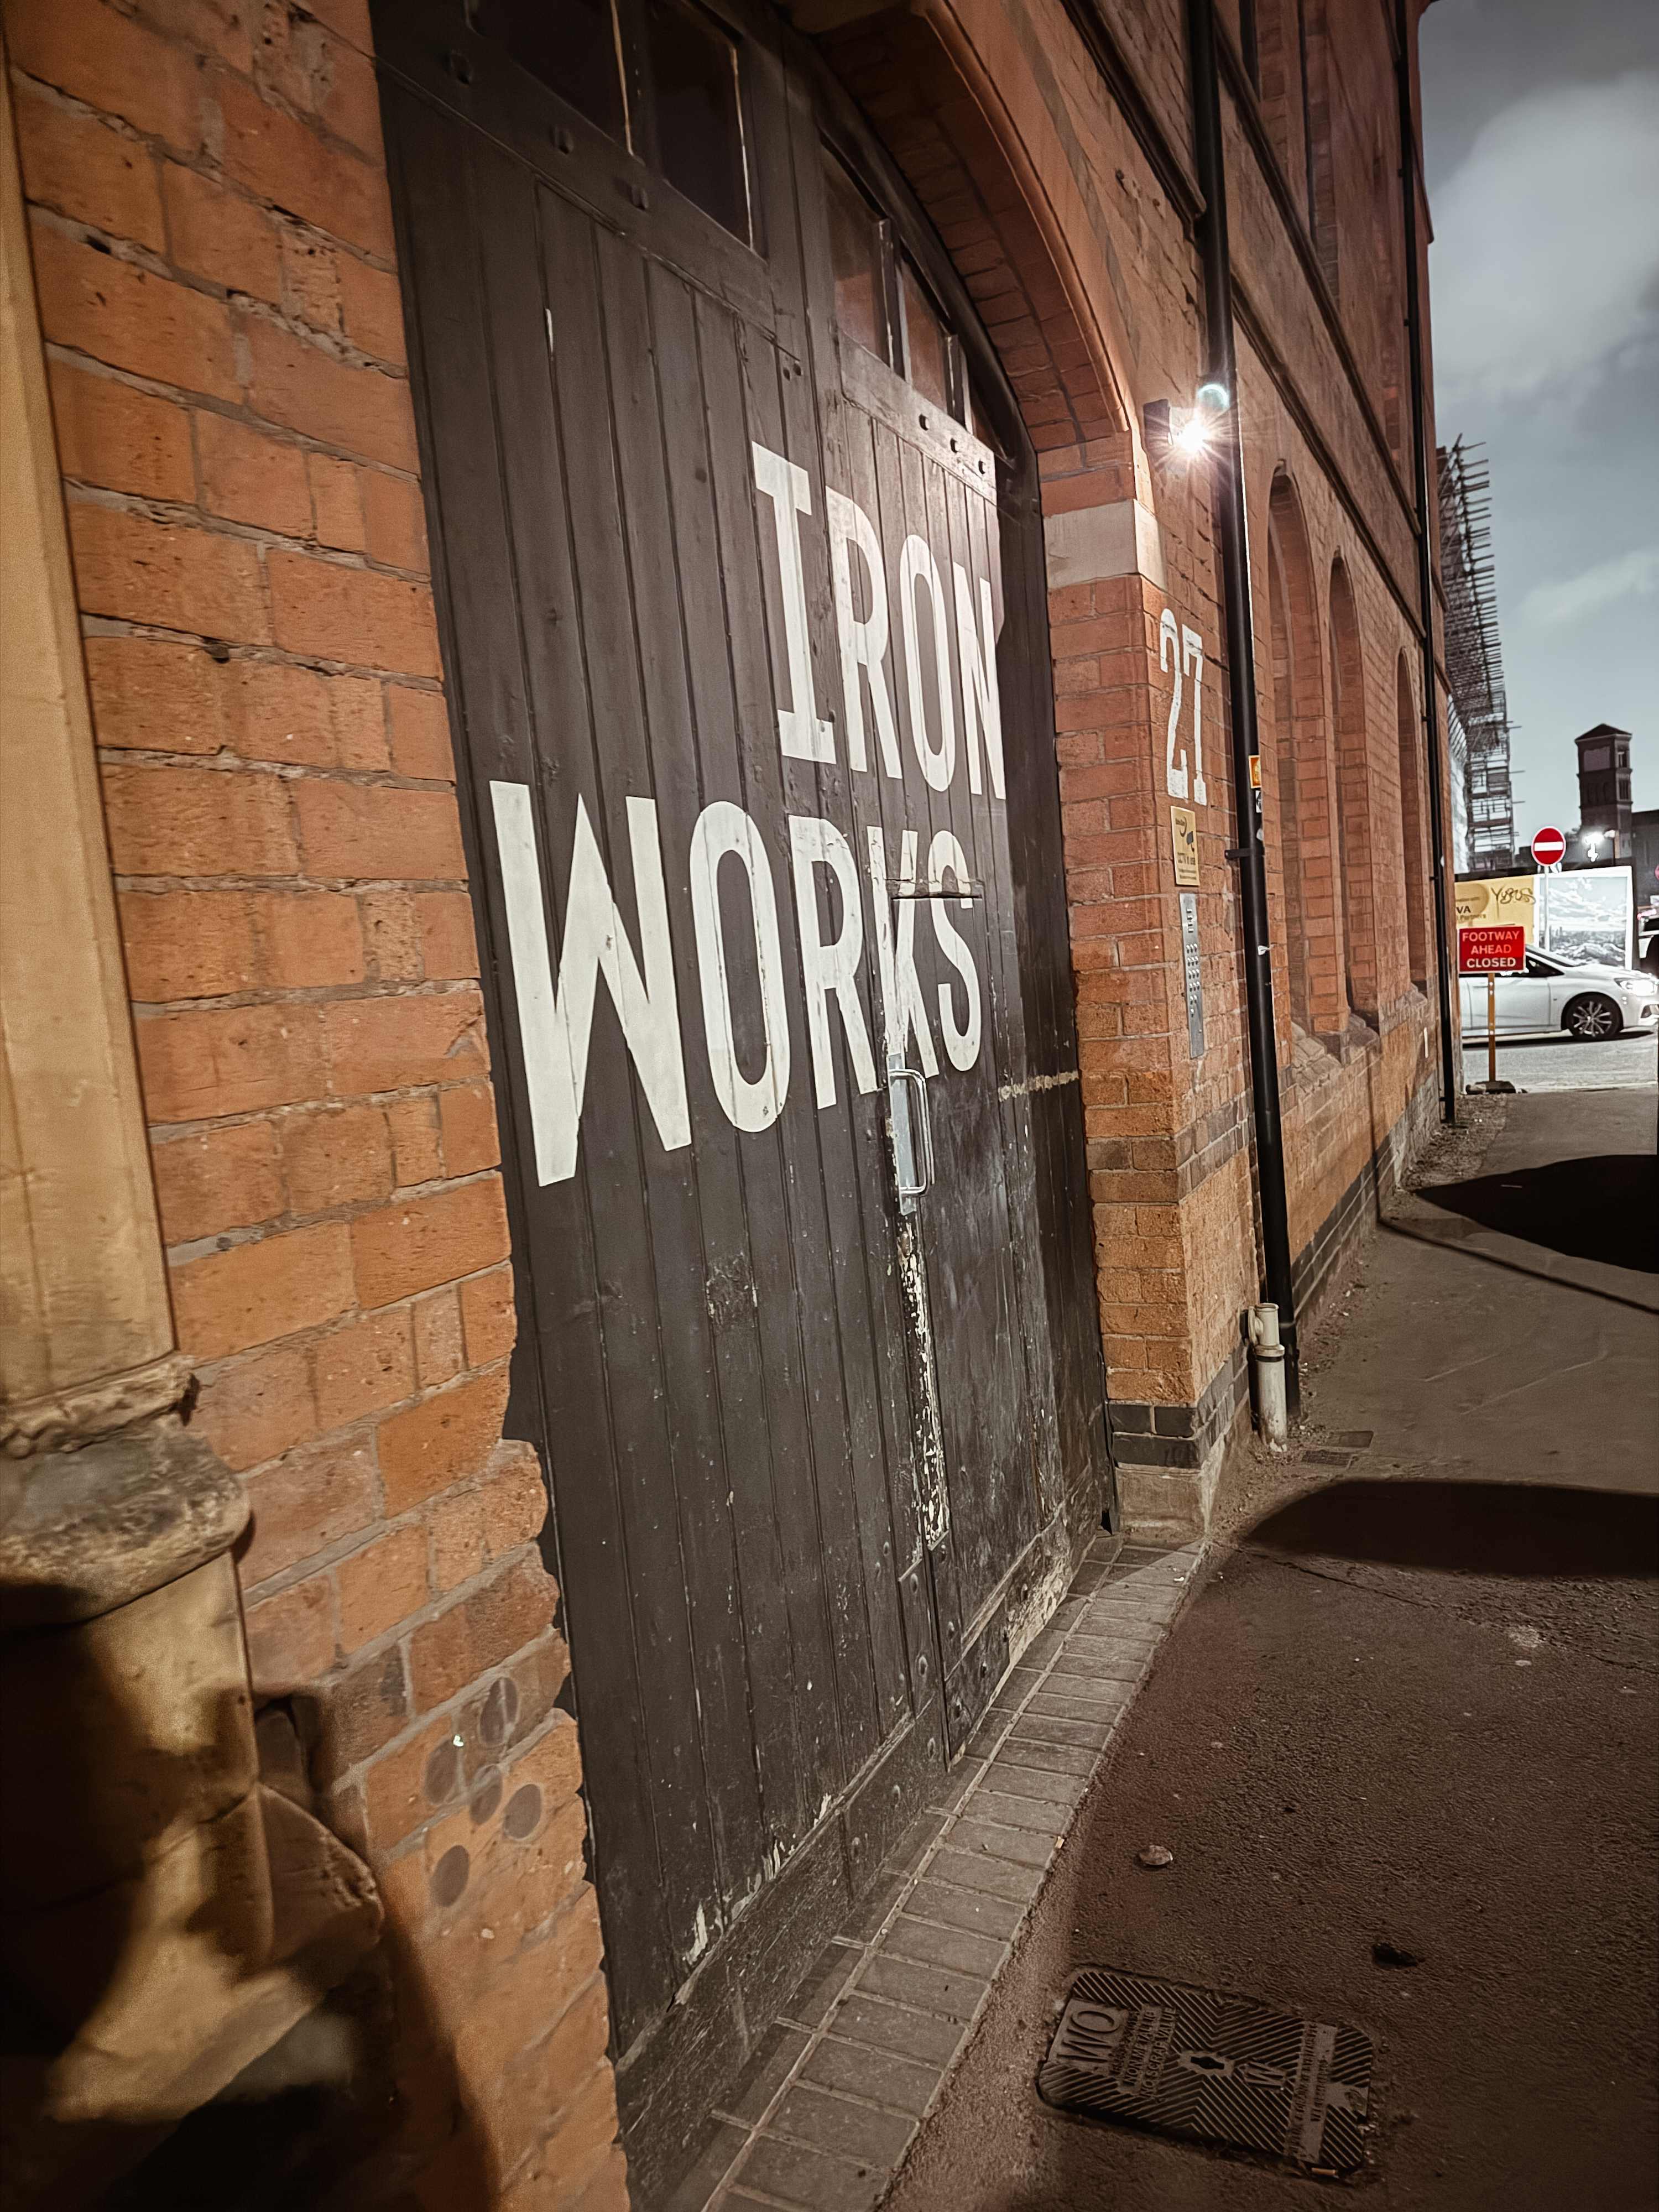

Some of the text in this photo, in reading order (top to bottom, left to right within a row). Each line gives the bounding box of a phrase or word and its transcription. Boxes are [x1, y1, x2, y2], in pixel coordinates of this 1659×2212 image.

[752, 441, 1006, 800] IRON
[1160, 608, 1207, 806] 27
[489, 780, 983, 1186] WORKS
[1462, 931, 1520, 942] FOOTWAY
[1467, 957, 1516, 968] CLOSED
[1470, 944, 1512, 954] AHEAD
